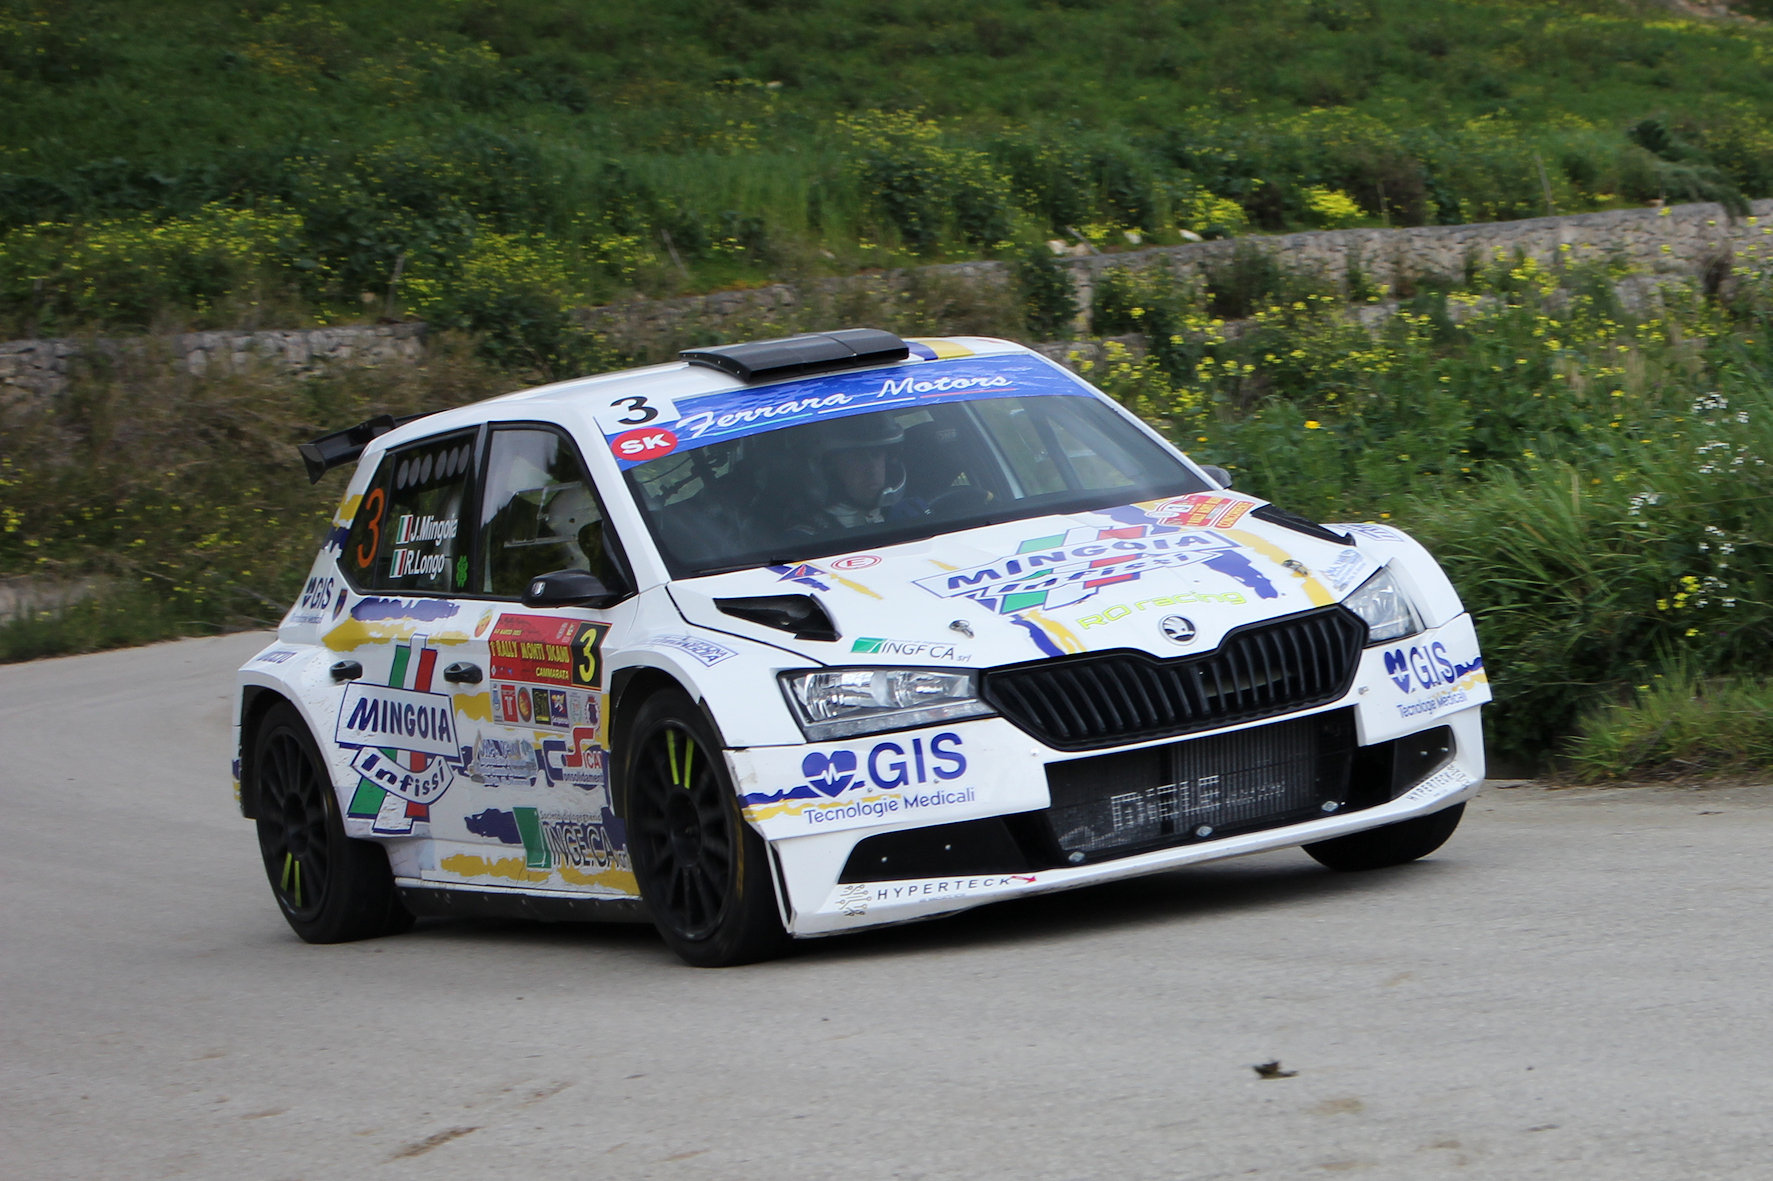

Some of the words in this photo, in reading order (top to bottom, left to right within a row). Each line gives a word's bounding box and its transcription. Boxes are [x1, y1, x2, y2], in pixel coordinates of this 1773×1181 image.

[609, 395, 659, 426] 3
[675, 393, 853, 438] Ferrara
[876, 373, 1014, 399] Motors
[619, 432, 671, 455] SK
[356, 487, 385, 569] 3
[403, 549, 445, 580] R.Longo
[947, 534, 1211, 590] MINGOIA
[310, 576, 334, 610] GIS
[1076, 600, 1132, 630] RO
[1134, 590, 1247, 612] racing
[578, 627, 598, 683] 3
[1410, 640, 1455, 690] GIS
[347, 697, 452, 743] MINGOIA
[361, 754, 445, 797] Infissi
[867, 731, 967, 790] GIS
[804, 797, 899, 825] Tecnologie
[904, 787, 975, 810] Medicali
[877, 876, 1013, 901] HYPERTECK
